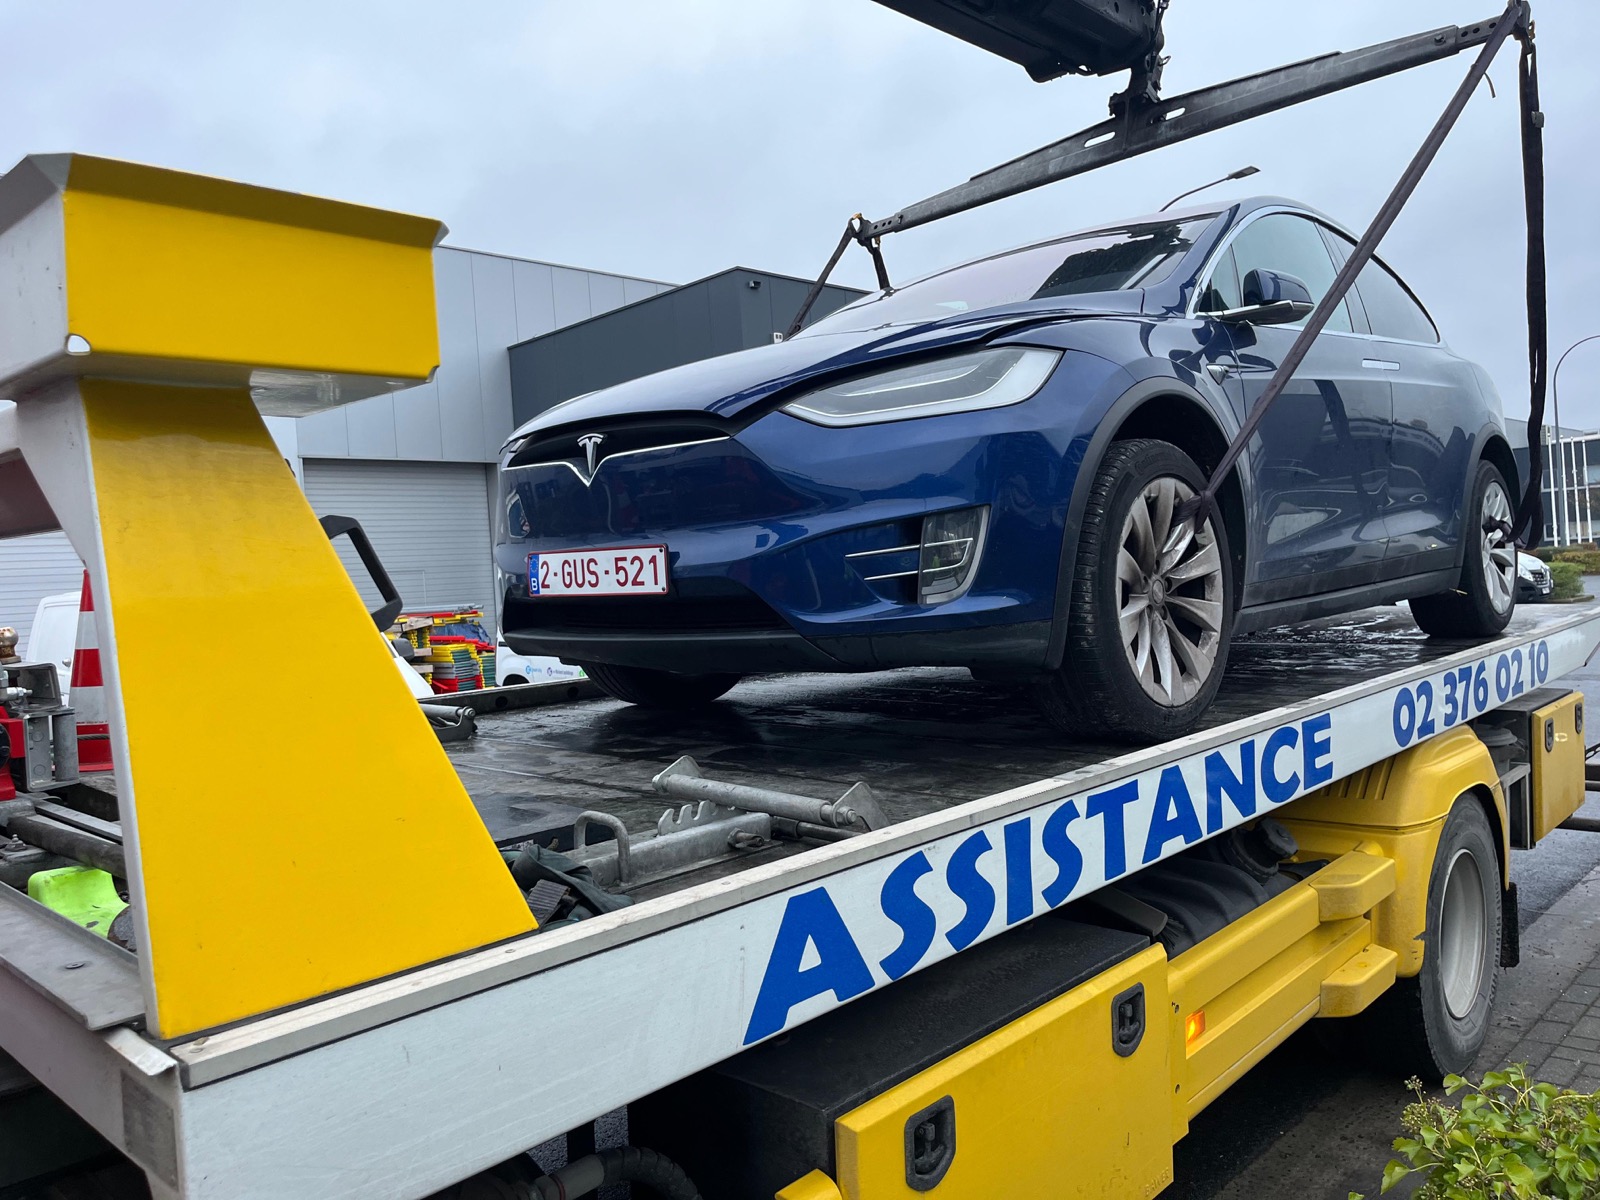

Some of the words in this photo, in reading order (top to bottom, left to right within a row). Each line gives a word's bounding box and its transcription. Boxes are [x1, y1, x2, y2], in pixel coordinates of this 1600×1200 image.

[531, 577, 538, 591] B
[540, 555, 659, 589] 2-GUS-521
[743, 714, 1333, 1045] ASSISTANCE
[1393, 681, 1435, 748] 02
[1443, 660, 1489, 727] 376
[1496, 649, 1524, 702] 02
[1529, 639, 1549, 688] 10
